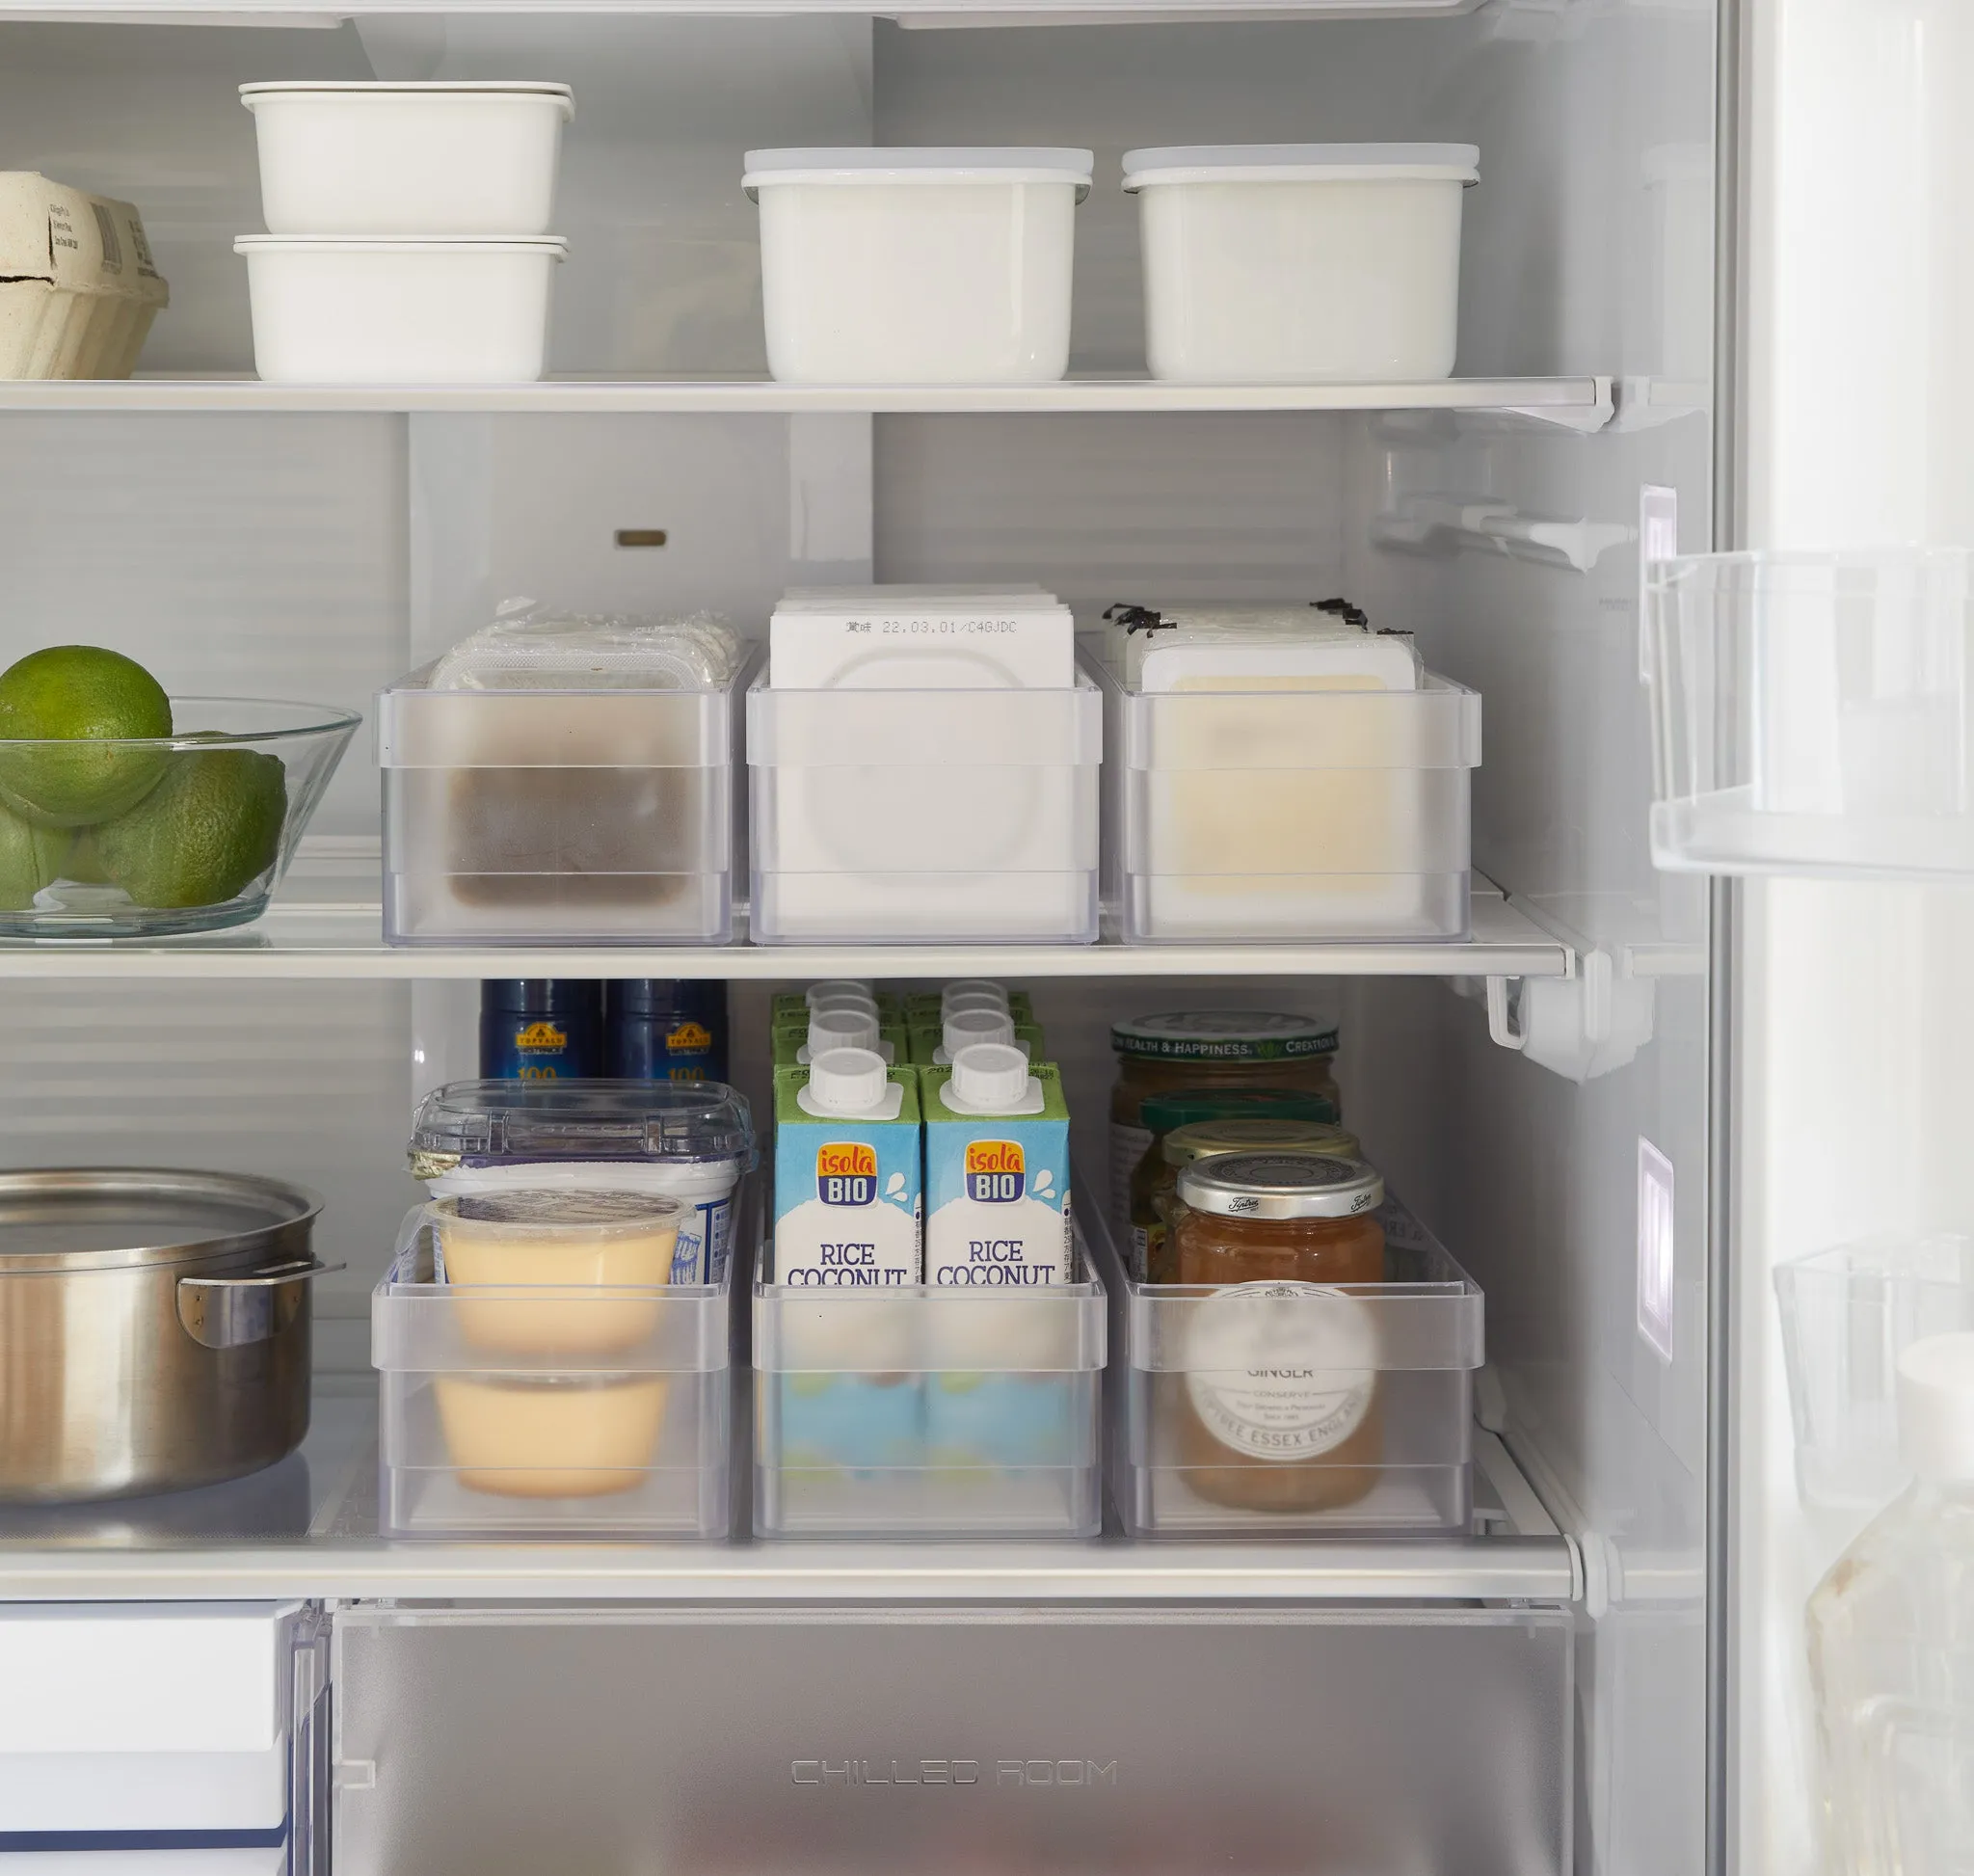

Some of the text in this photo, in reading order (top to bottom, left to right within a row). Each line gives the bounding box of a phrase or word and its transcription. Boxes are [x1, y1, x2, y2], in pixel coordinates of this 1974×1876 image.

[1161, 1041, 1170, 1053] &
[821, 1145, 873, 1174] isola
[969, 1143, 1021, 1173] isola
[827, 1177, 867, 1202] BIO
[975, 1174, 1015, 1199] BIO
[820, 1243, 875, 1266] RICE
[969, 1240, 1024, 1263] RICE
[787, 1268, 907, 1285] COCONUT
[937, 1265, 1055, 1285] COCONUT
[1251, 1431, 1302, 1447] ESSEX
[790, 1760, 1118, 1784] CHILLED ROOM
